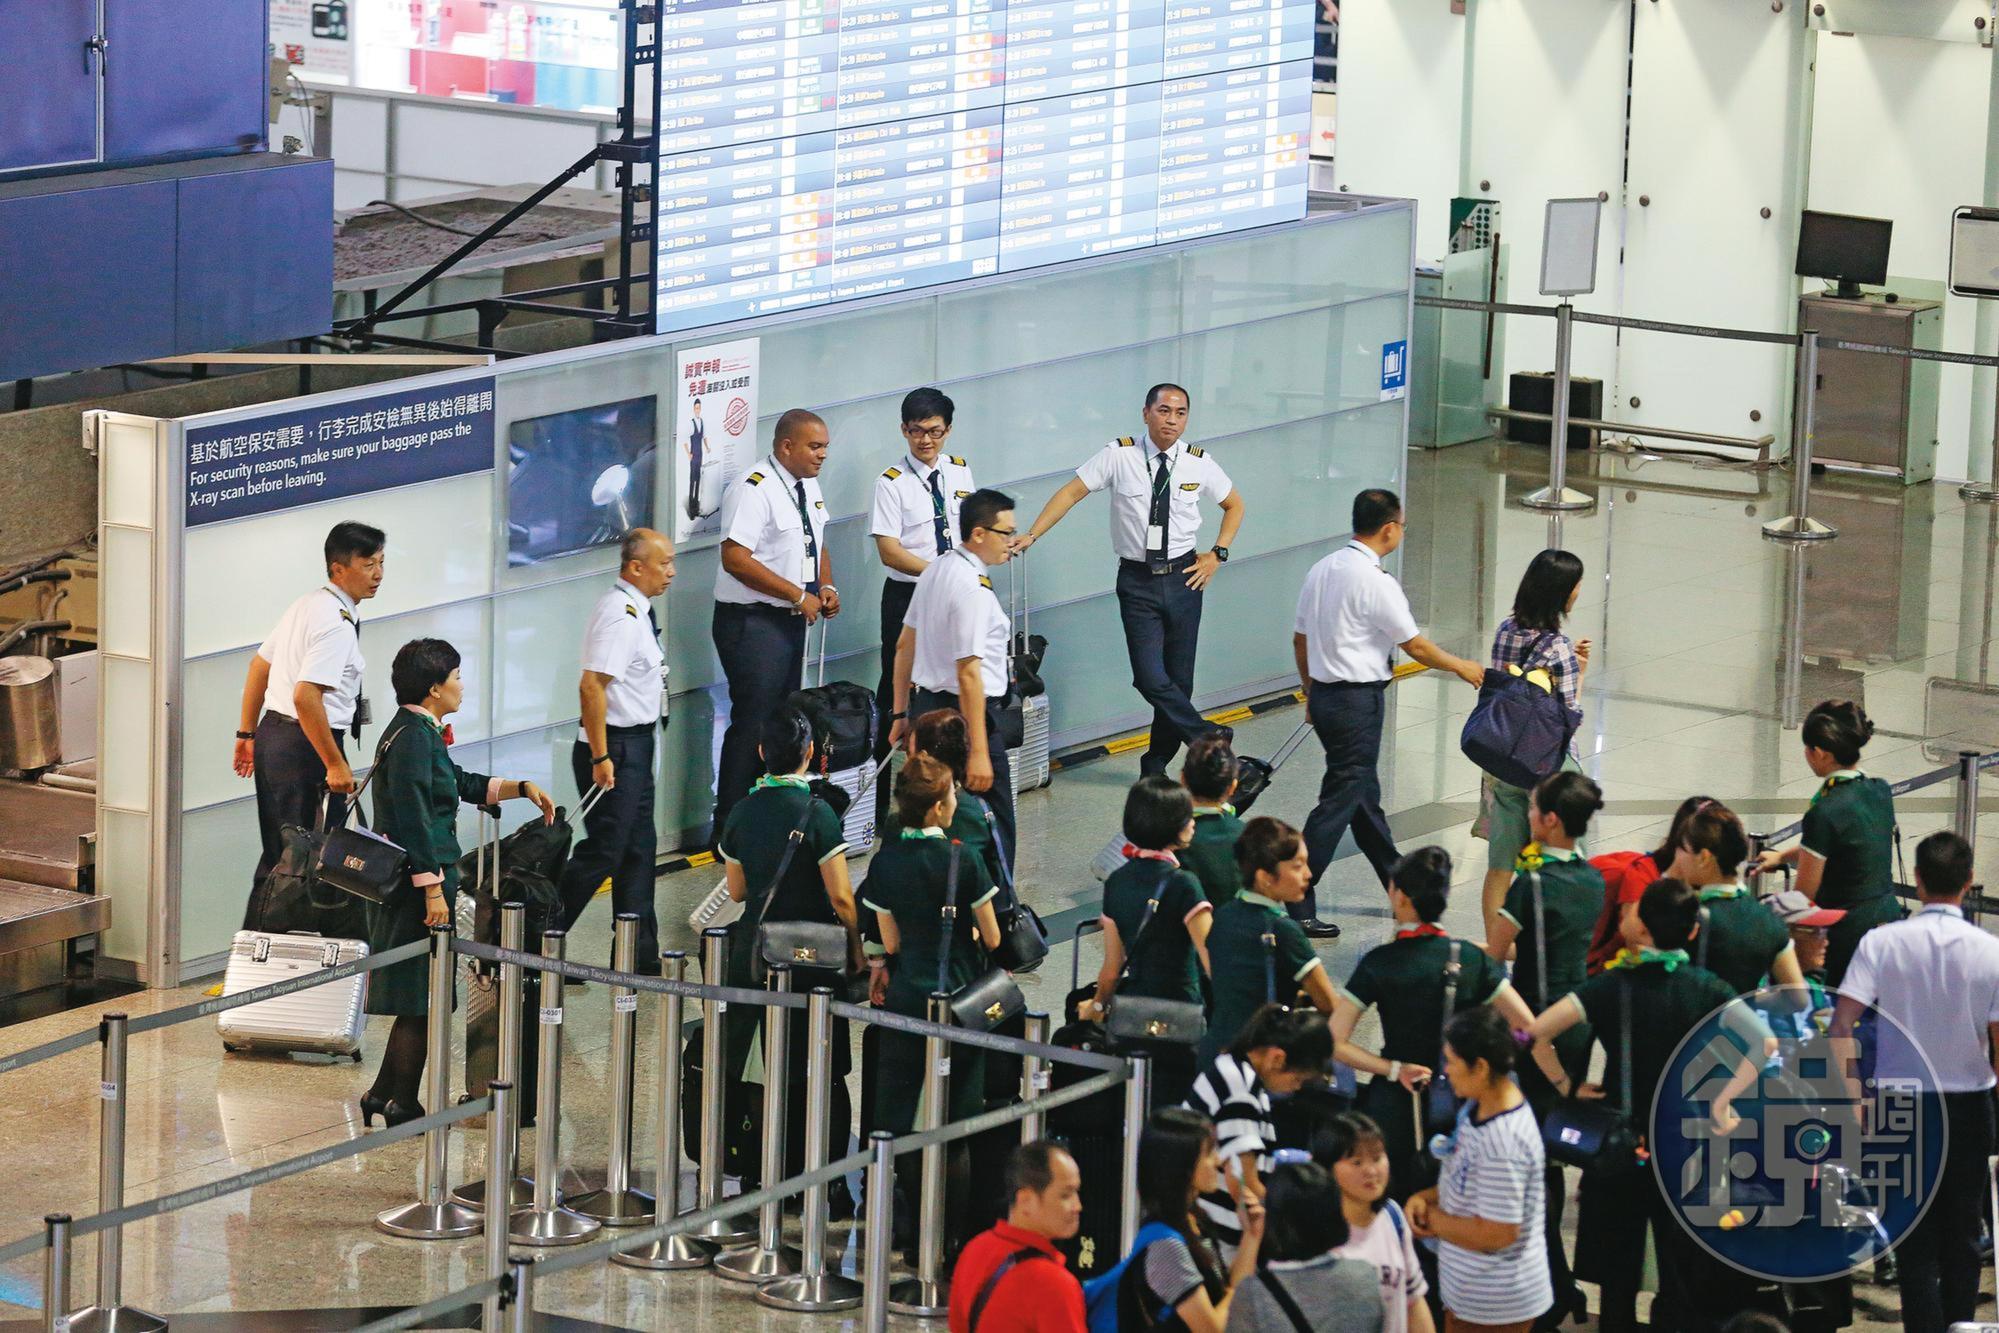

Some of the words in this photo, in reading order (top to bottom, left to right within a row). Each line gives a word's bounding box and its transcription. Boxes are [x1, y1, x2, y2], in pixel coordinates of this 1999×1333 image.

[190, 471, 209, 487] For
[210, 463, 252, 484] security
[254, 456, 300, 475] reasons,
[301, 448, 330, 464] make
[332, 446, 354, 461] sure
[355, 440, 380, 461] your
[382, 432, 428, 453] baggage
[430, 428, 453, 447] pass
[454, 422, 472, 438] the
[190, 488, 219, 508] X-ray
[220, 486, 245, 501] scan
[247, 475, 283, 496] before
[285, 469, 327, 488] leaving.
[272, 982, 297, 996] Taoyuan
[297, 970, 334, 988] International
[334, 965, 356, 980] Airport
[563, 962, 589, 976] Taiwan
[590, 968, 623, 984] Taoyuan
[624, 975, 673, 992] International
[673, 982, 702, 996] Airport
